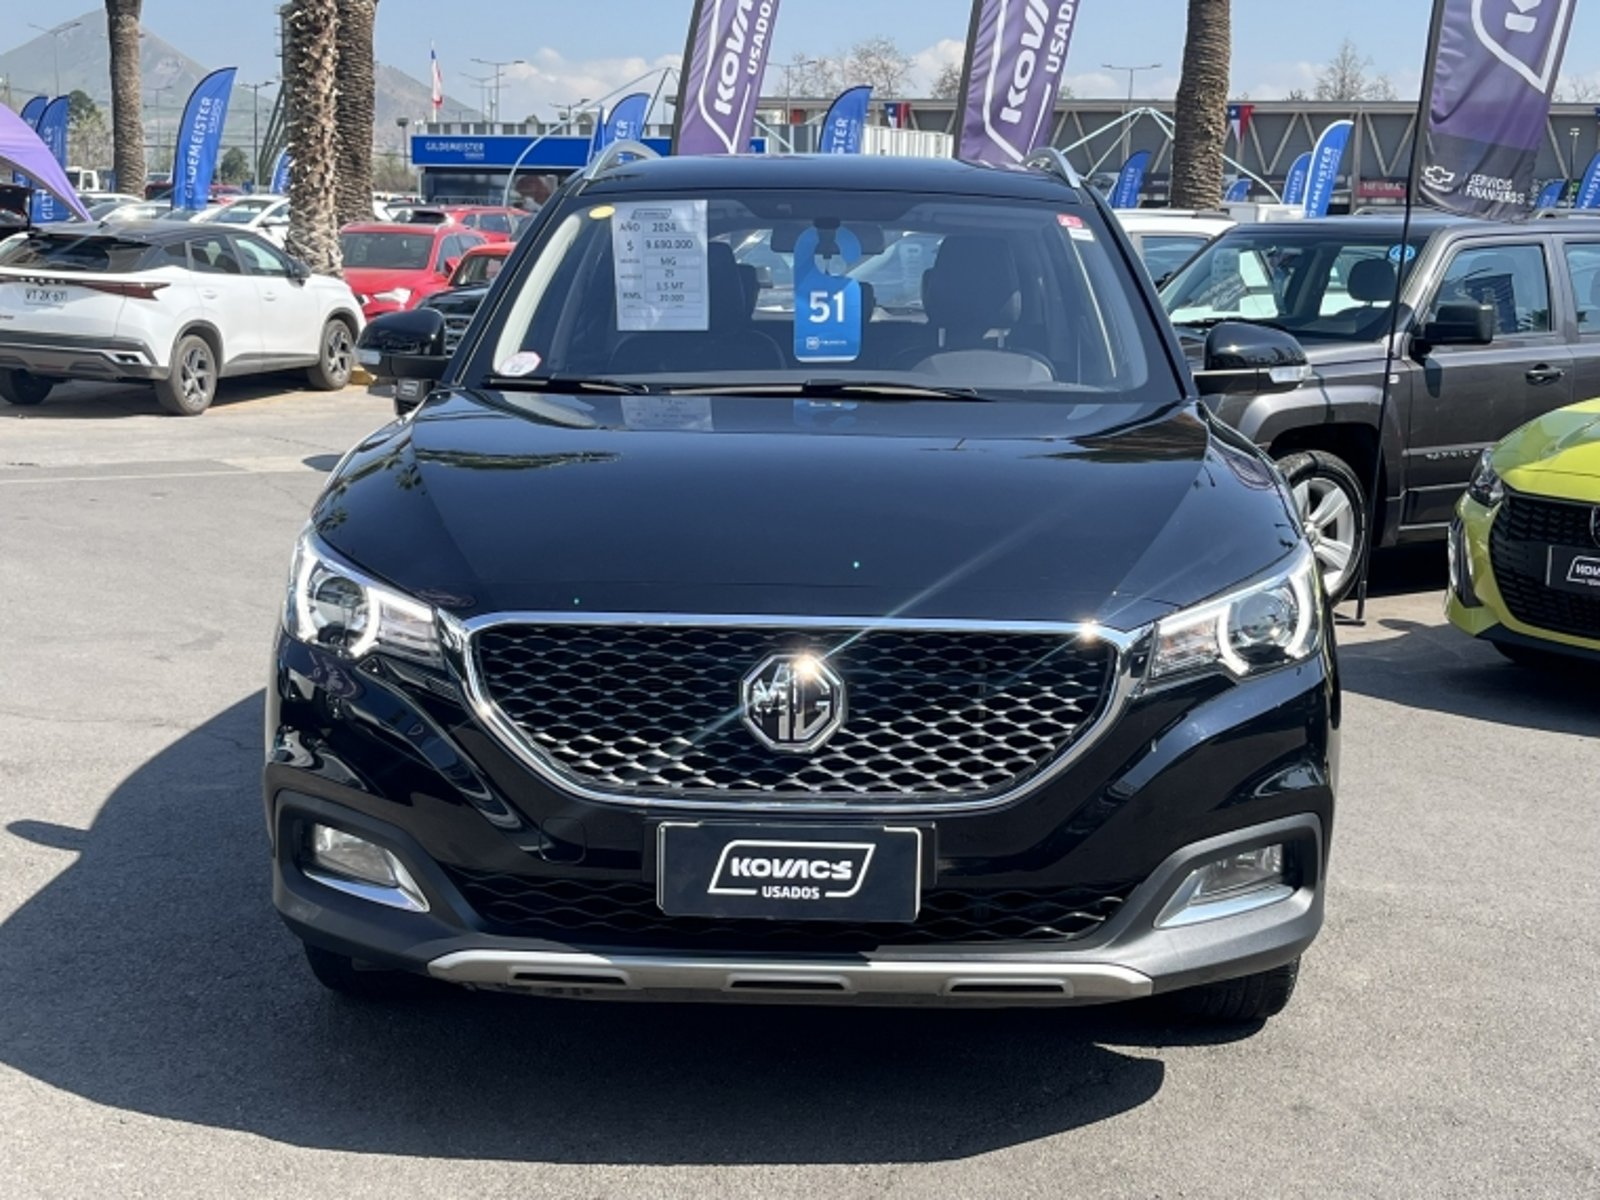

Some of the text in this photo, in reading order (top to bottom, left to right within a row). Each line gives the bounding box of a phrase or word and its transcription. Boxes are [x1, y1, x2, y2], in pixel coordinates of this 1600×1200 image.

[747, 0, 773, 75] USADO
[1045, 0, 1074, 73] USAD
[619, 221, 641, 232] AÑO
[808, 290, 844, 323] 51
[752, 661, 831, 741] MG
[731, 857, 853, 880] KOVACS
[761, 885, 820, 900] USADOS
